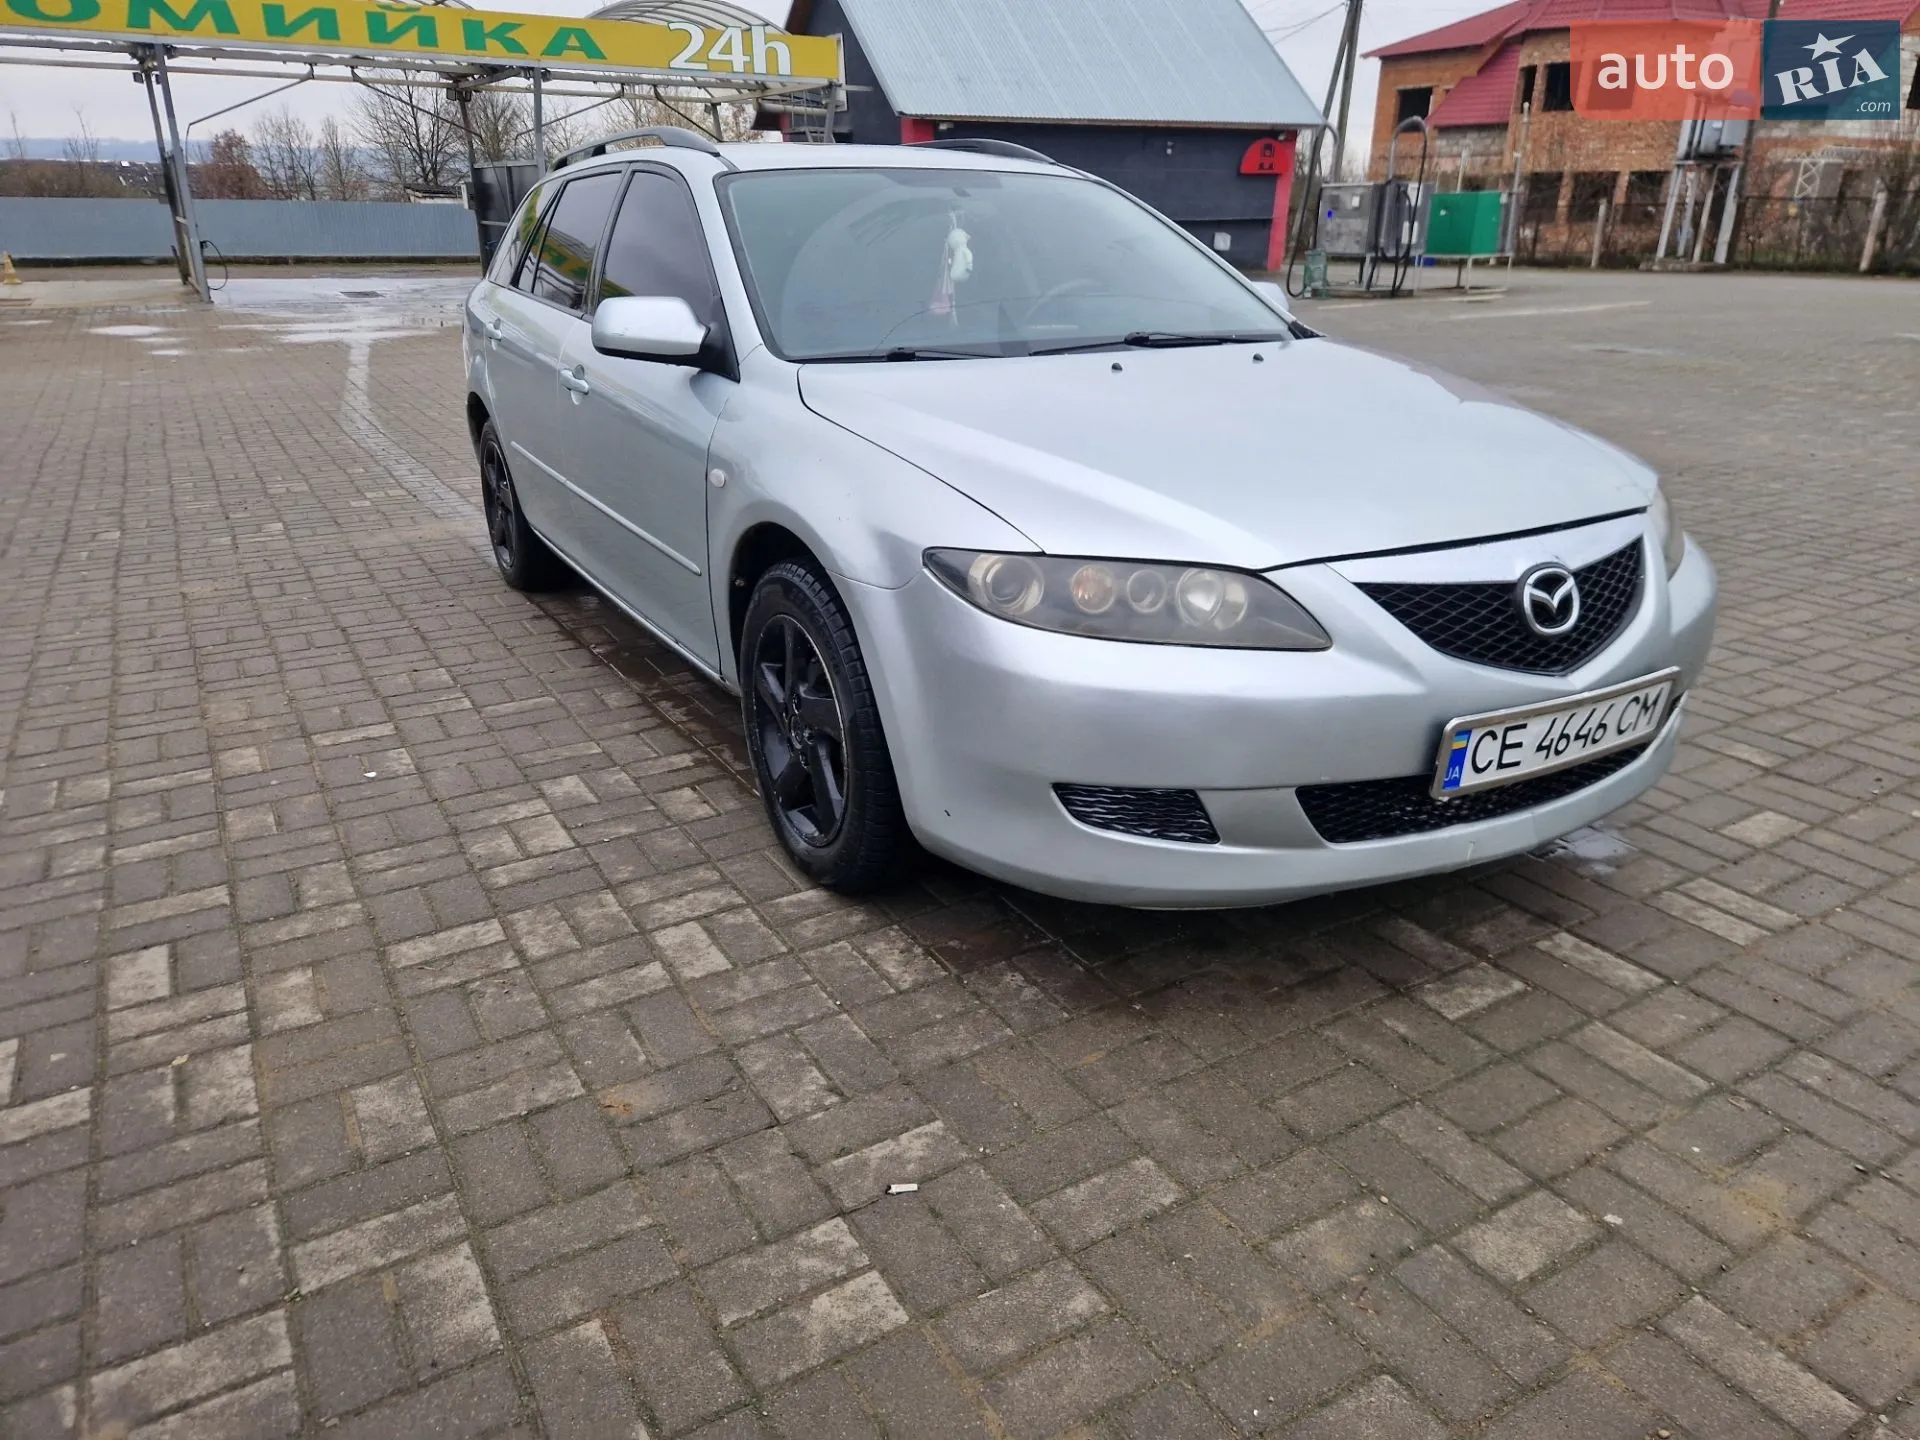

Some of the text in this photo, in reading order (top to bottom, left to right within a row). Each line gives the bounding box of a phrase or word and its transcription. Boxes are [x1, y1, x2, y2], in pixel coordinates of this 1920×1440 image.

[668, 22, 792, 76] 24h
[1471, 687, 1663, 775] CE 4646 CM
